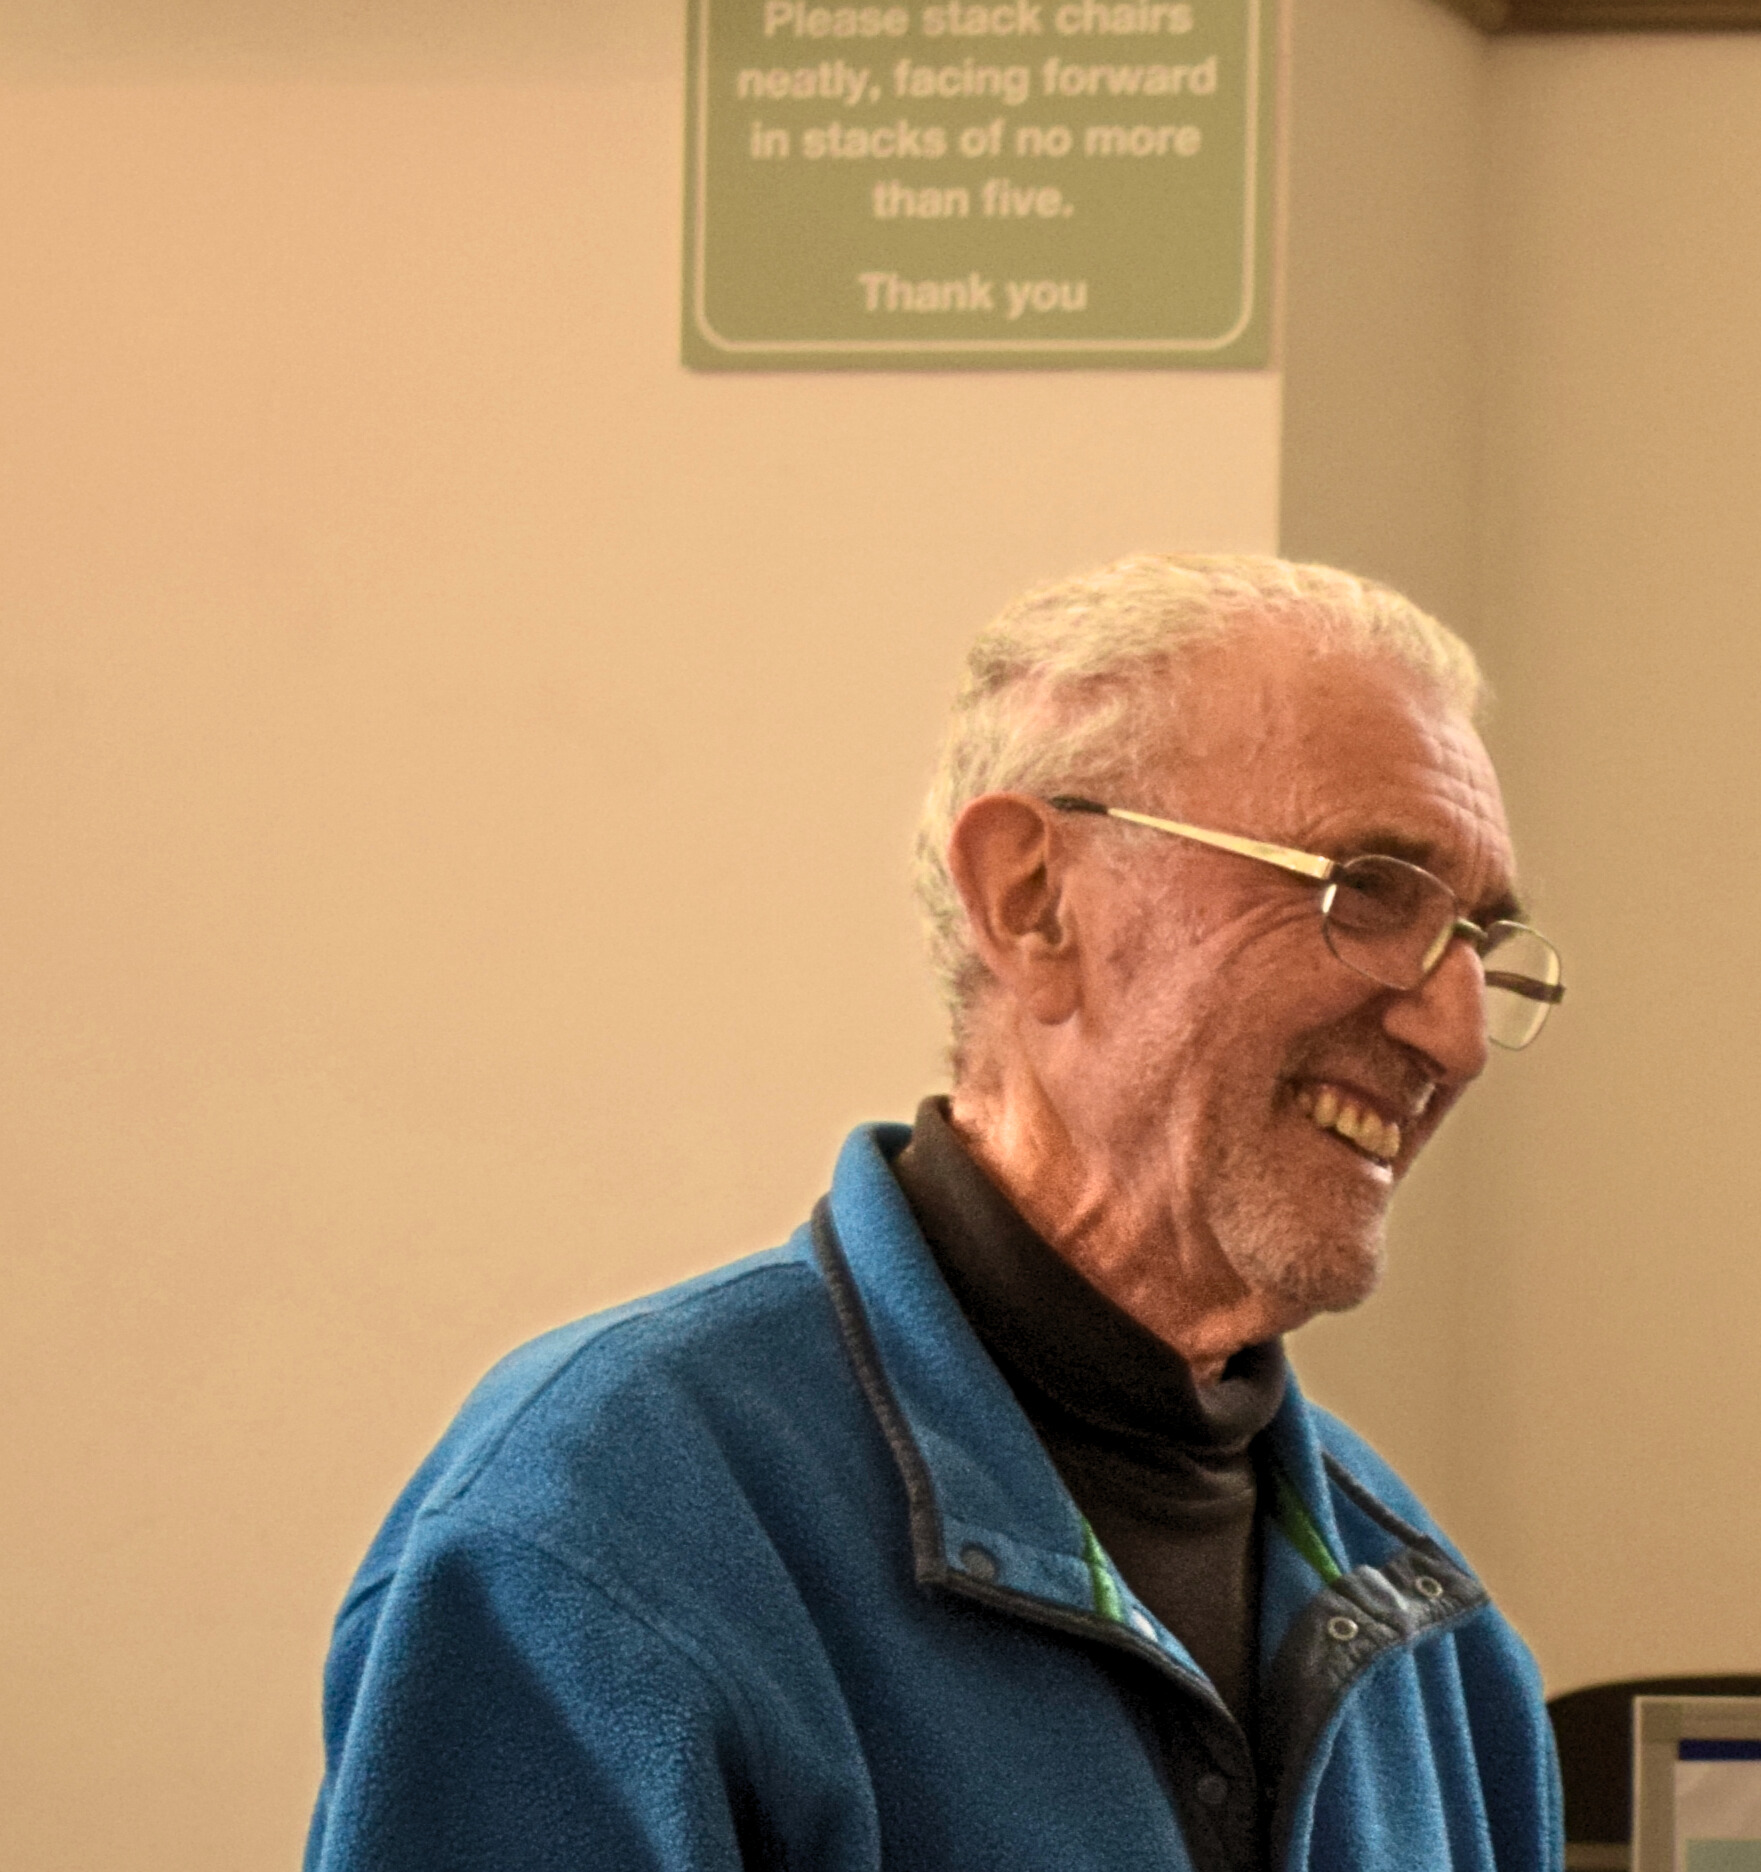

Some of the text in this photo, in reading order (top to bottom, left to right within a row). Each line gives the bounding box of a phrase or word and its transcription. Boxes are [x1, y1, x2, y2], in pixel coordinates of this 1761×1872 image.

[764, 0, 1193, 37] Please stack chairs
[737, 56, 1218, 106] neatly, facing forward
[750, 118, 1201, 159] in stacks of no more
[872, 178, 1074, 219] than five.
[859, 272, 1088, 320] Thank you
